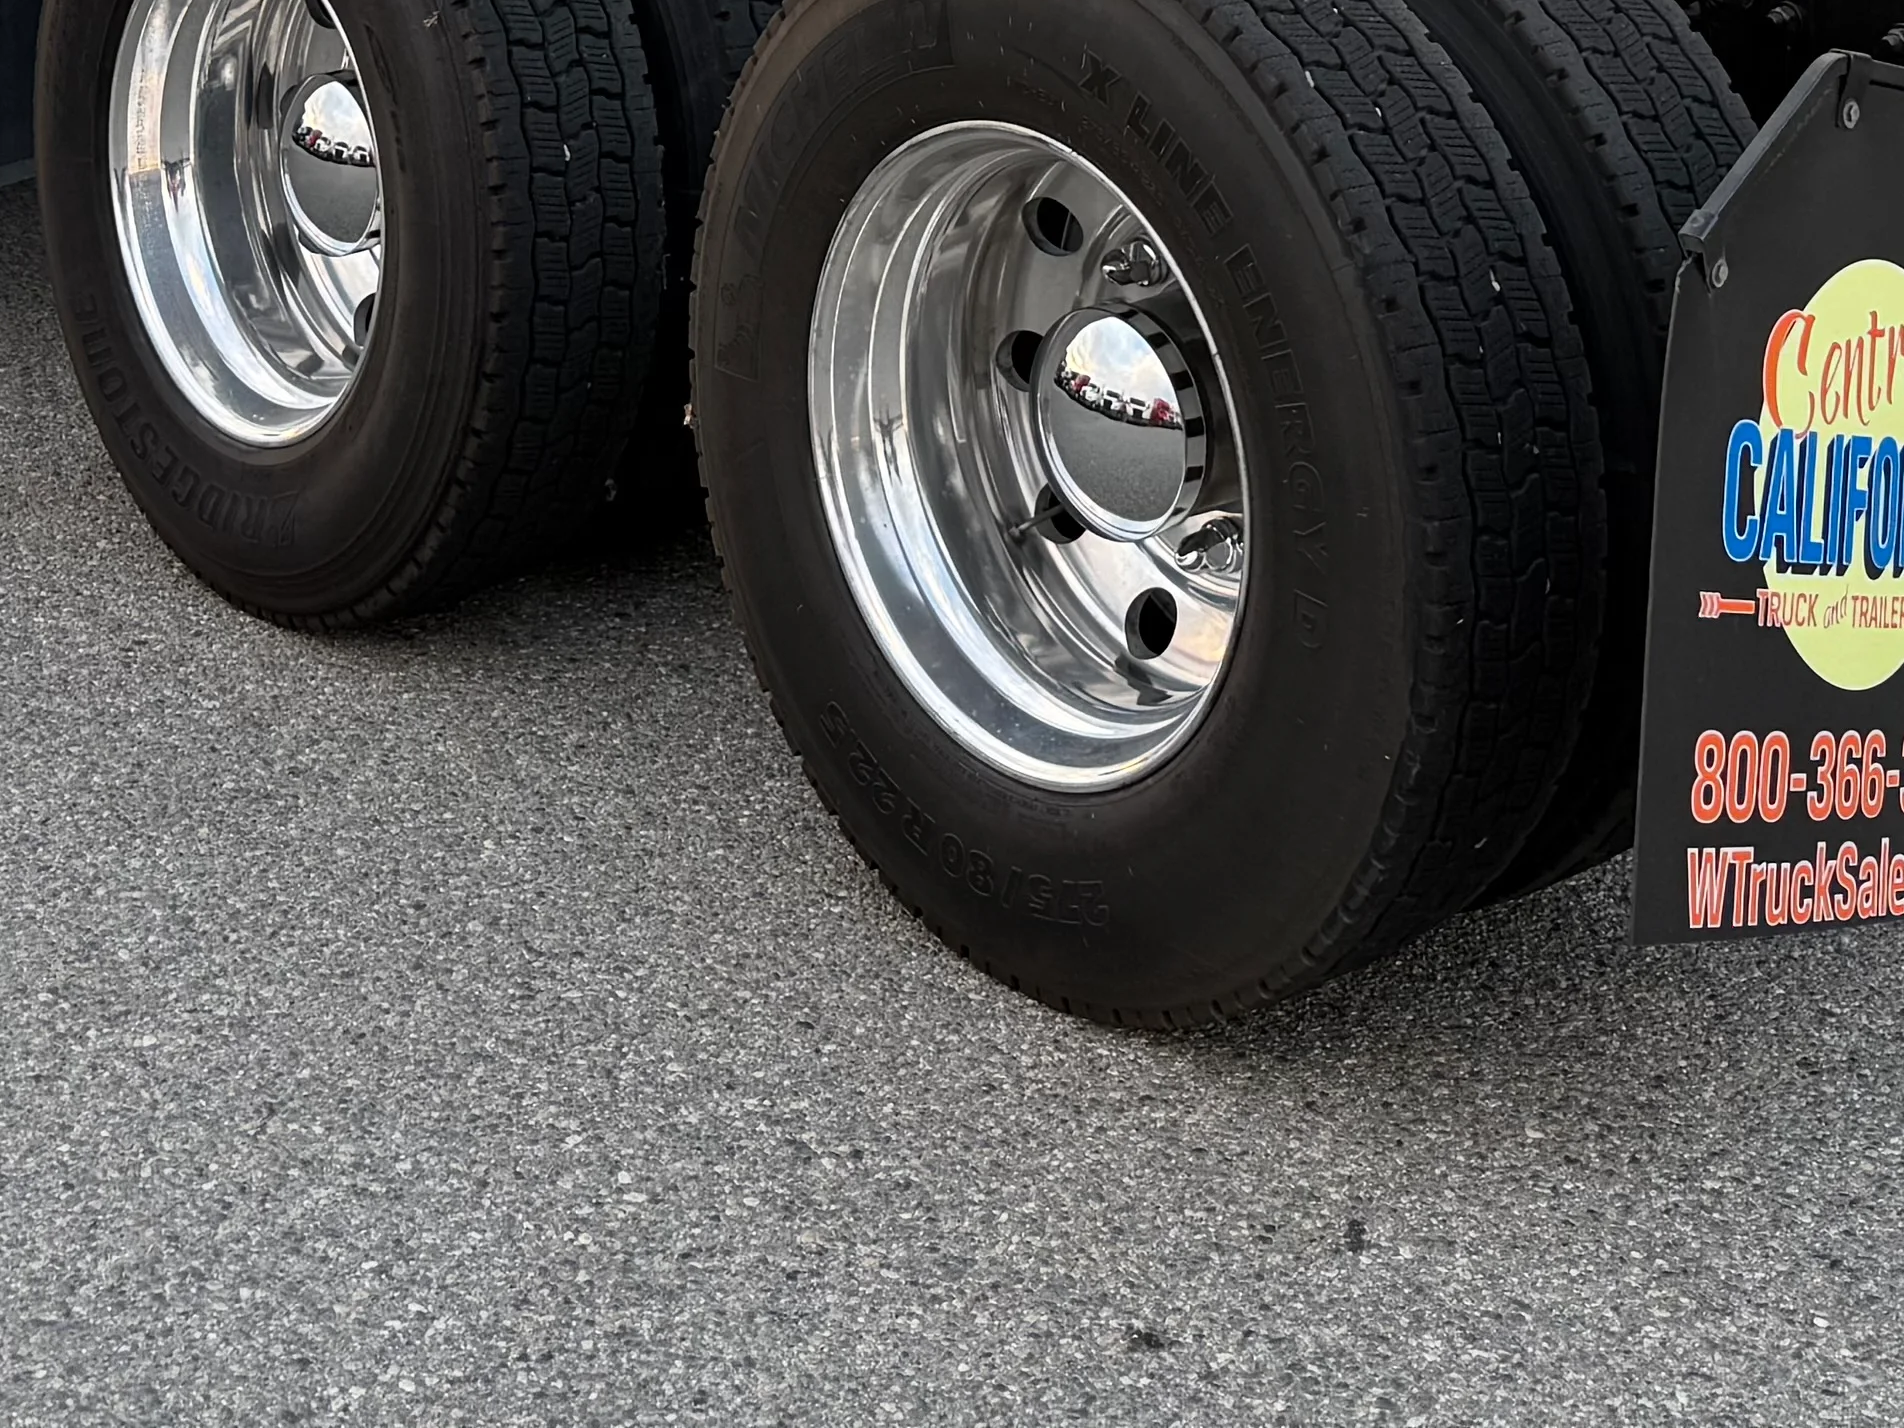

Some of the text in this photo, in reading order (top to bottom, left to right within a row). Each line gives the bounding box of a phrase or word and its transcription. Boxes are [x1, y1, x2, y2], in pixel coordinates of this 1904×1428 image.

[72, 288, 300, 548] BRIDGESTONE
[1078, 47, 1123, 110] X
[1123, 89, 1236, 238] LINE
[1221, 240, 1331, 576] ENERGY
[1756, 588, 1818, 629] TRUCK
[1823, 584, 1850, 630] and
